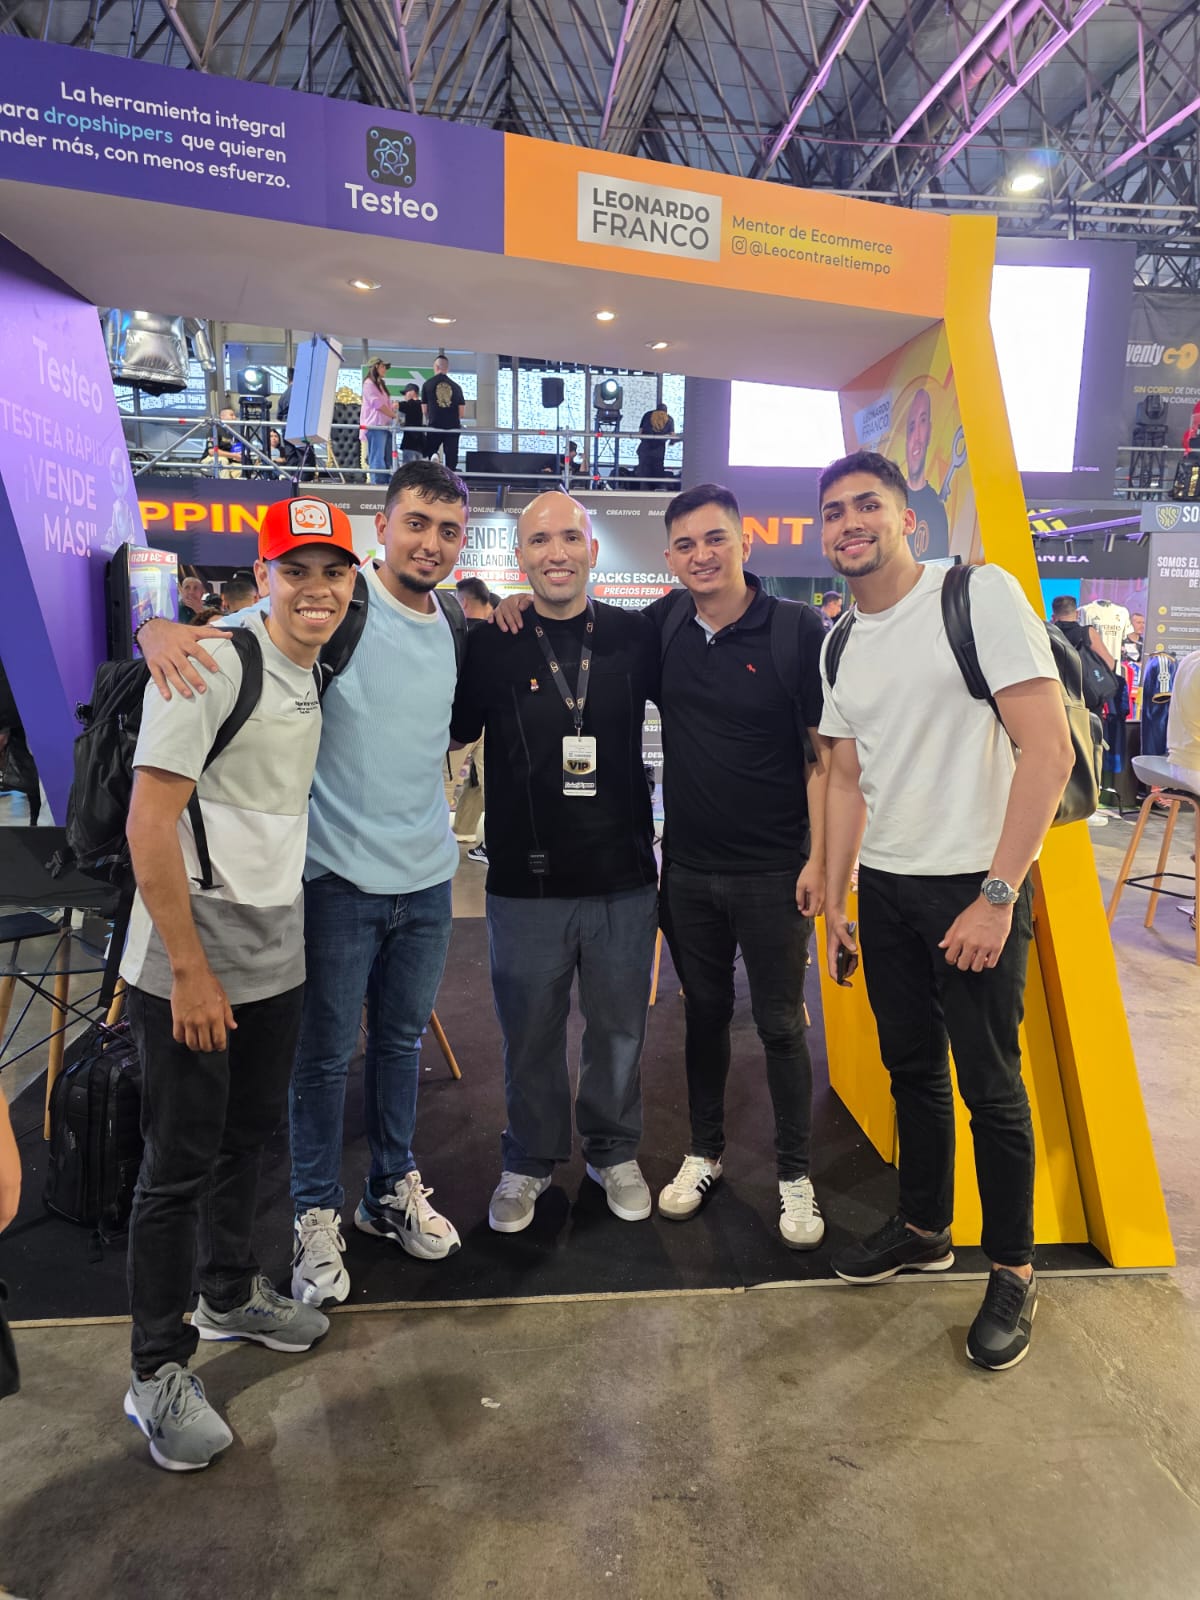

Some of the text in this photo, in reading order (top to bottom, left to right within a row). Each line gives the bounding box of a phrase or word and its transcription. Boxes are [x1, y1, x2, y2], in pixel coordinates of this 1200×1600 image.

[60, 81, 286, 139] La herramienta integral
[43, 106, 174, 144] dropshippers
[181, 133, 215, 155] que
[218, 139, 287, 164] quieren
[52, 134, 100, 160] más,
[104, 145, 139, 165] con
[143, 150, 205, 175] menos
[208, 160, 291, 189] esfuerzo.
[344, 182, 438, 222] Testeo
[592, 187, 711, 224] LEONARDO
[592, 209, 710, 251] FRANCO
[731, 215, 893, 256] Mentor de Ecommerce
[749, 239, 891, 275] @Leocontraeltiempo
[33, 335, 103, 414] Testeo
[0, 397, 109, 467] TESTEA RÁPID
[24, 454, 97, 511] ¡VENDE
[139, 501, 268, 534] PPIN
[742, 516, 814, 545] NT
[466, 526, 508, 550] ENDE
[454, 551, 478, 567] ÑAR
[589, 571, 680, 584] PACKS ESCALA
[1157, 556, 1187, 567] SOMOS
[603, 587, 665, 596] PRECIOS FERIA
[569, 761, 589, 771] VIP
